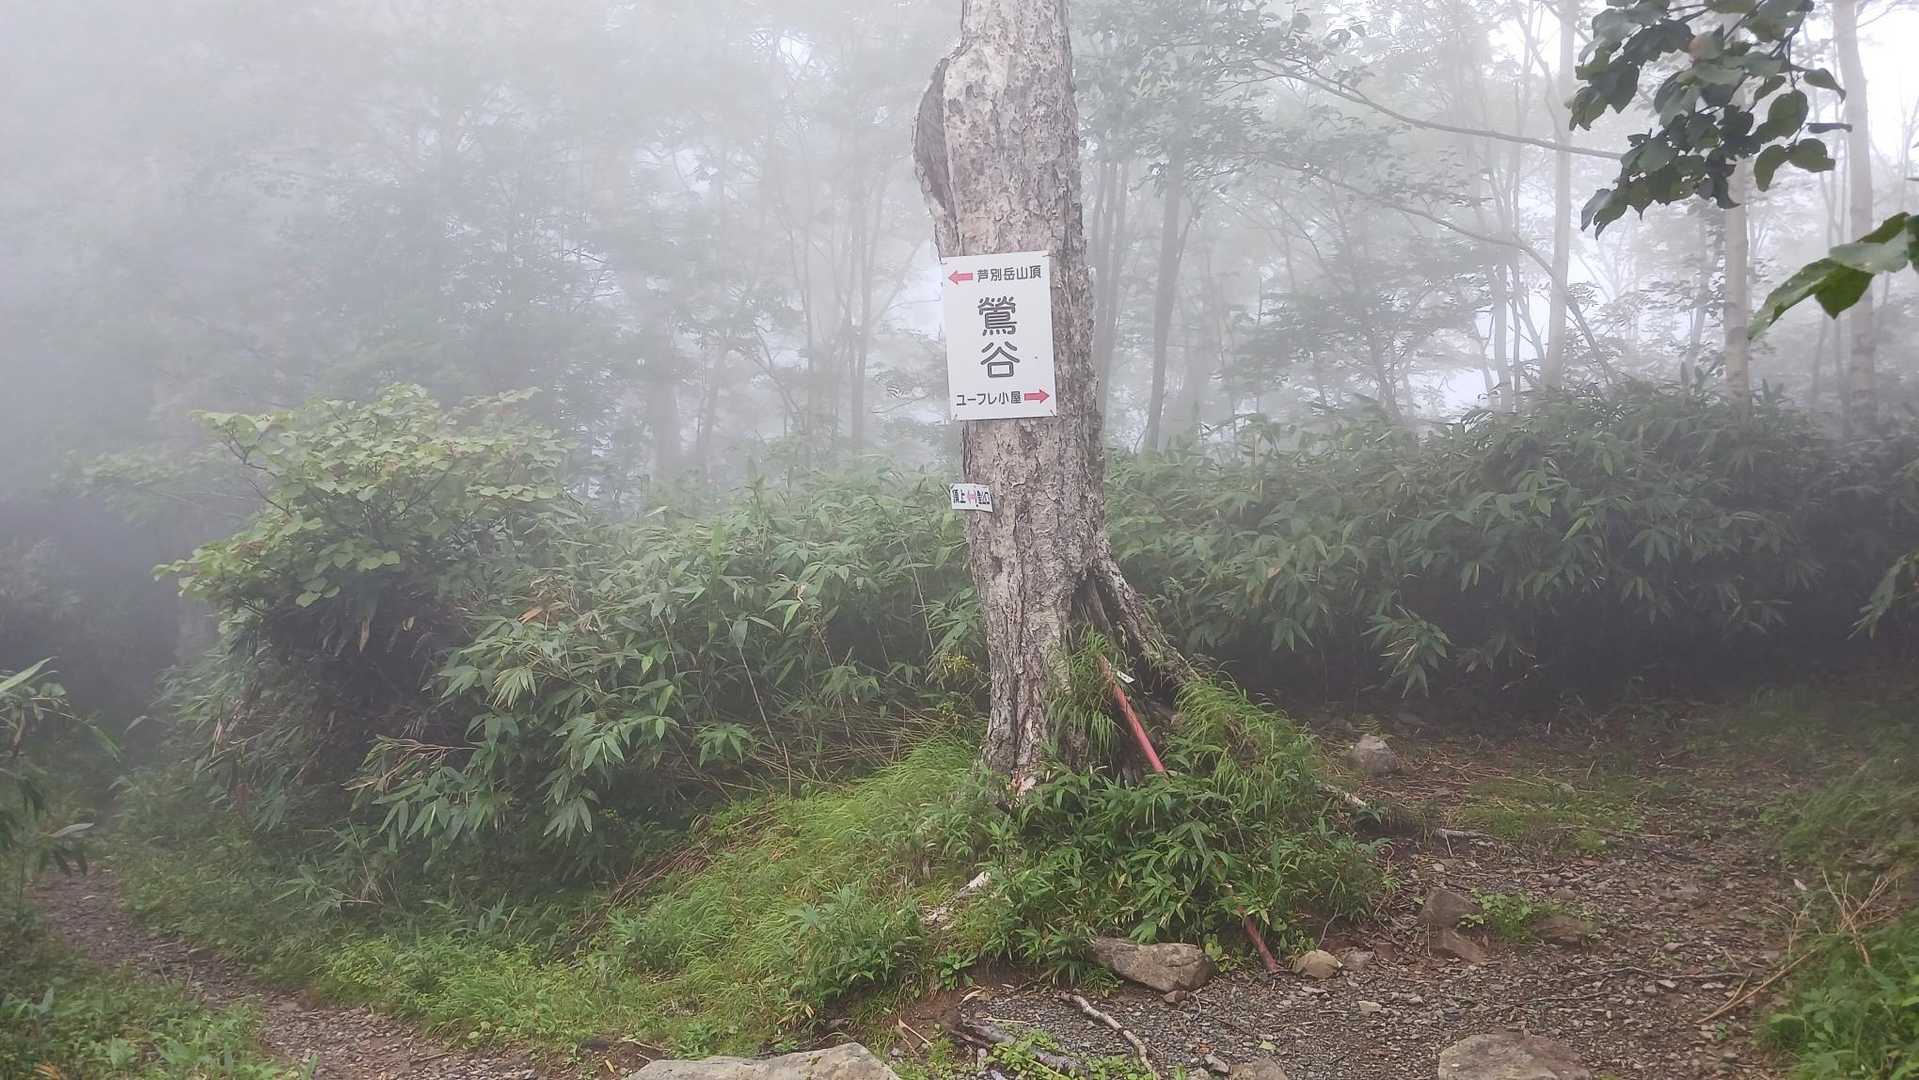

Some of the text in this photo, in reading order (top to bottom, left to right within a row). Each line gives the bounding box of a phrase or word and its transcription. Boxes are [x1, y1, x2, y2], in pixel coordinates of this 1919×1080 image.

[977, 265, 1042, 283] 芦別岳山頂
[977, 296, 1020, 378] 鶯谷
[956, 391, 1022, 406] ユーフレ小屋
